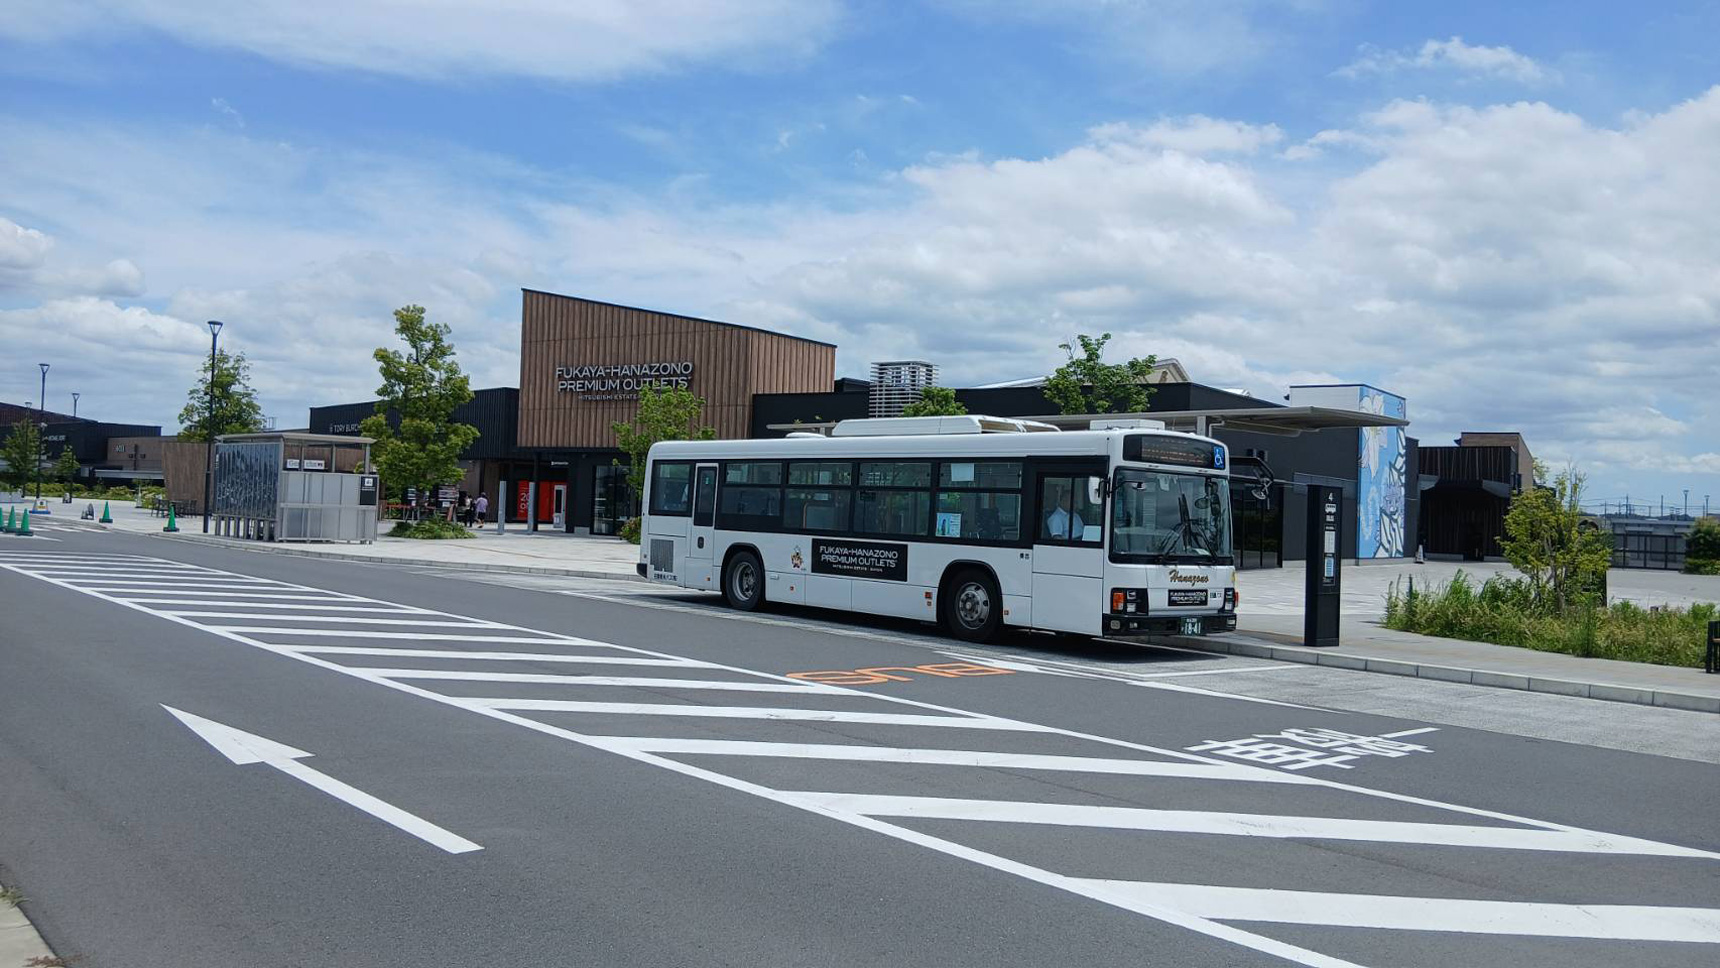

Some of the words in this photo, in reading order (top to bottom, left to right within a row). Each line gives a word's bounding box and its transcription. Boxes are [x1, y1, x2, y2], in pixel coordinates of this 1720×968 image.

[555, 362, 692, 379] FUKAYA-HANAZONO
[558, 379, 620, 392] PREMIUM
[622, 377, 688, 391] OUTLETS
[1328, 492, 1334, 502] 4
[820, 546, 898, 559] FUKAYA-HANAZONO
[821, 554, 858, 566] PREMIUM
[858, 557, 896, 568] OUTLETS
[1169, 569, 1209, 587] Hanazono
[786, 661, 1017, 685] BUS
[1183, 727, 1442, 770] 一般車
